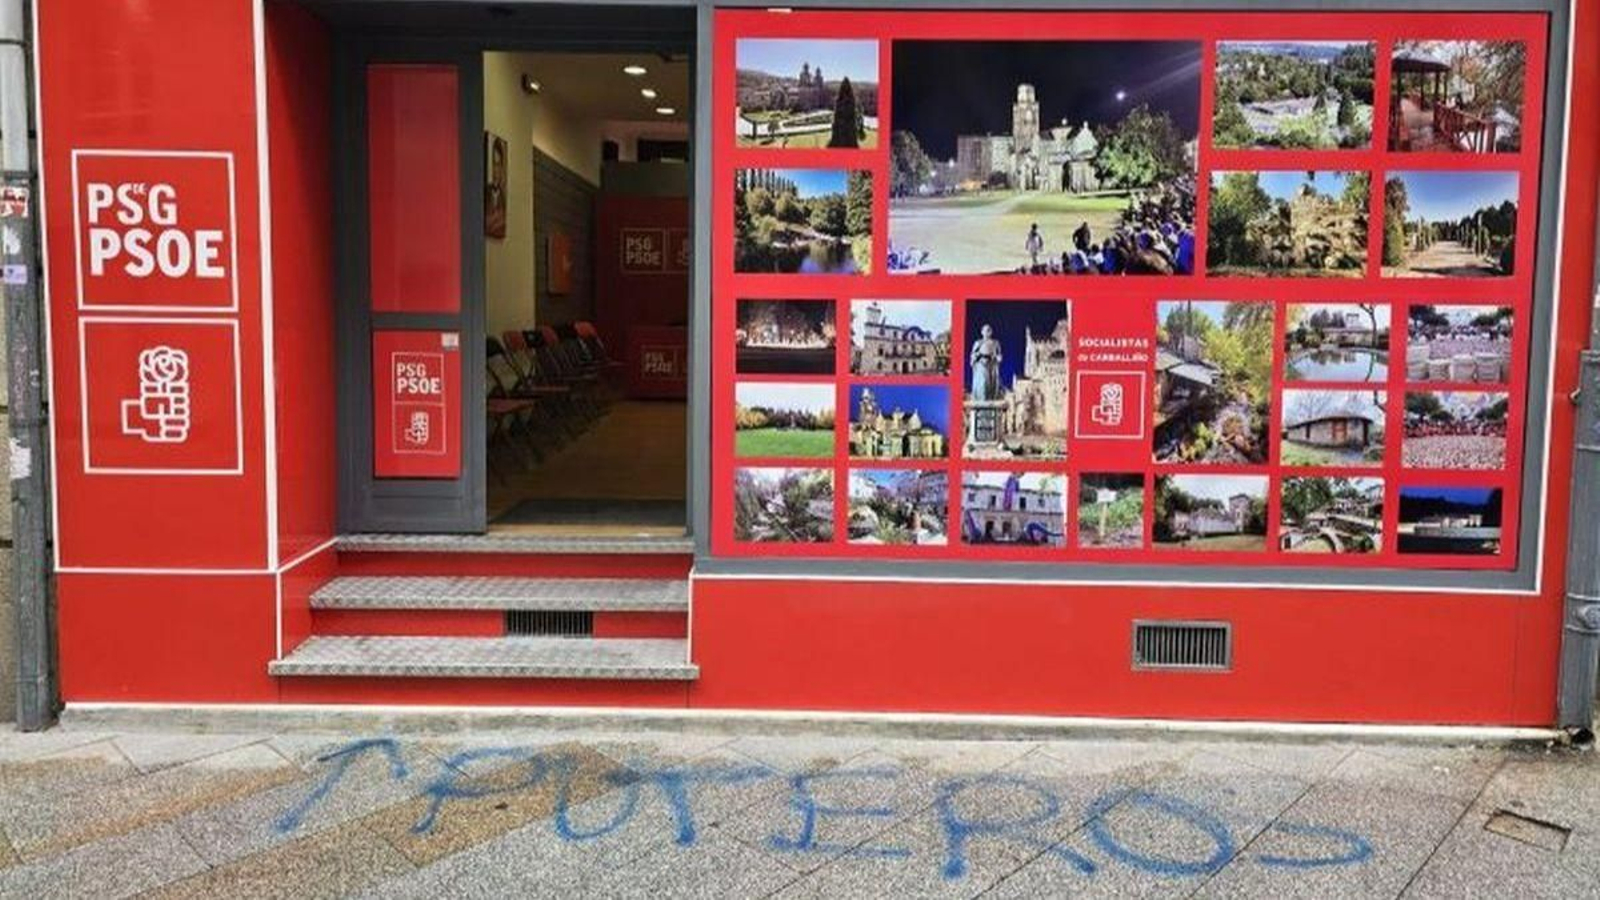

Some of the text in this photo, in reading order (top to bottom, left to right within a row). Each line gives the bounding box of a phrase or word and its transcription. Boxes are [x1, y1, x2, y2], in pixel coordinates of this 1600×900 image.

[90, 228, 225, 278] PSOE
[1078, 337, 1148, 348] SOCIALISTAS
[396, 362, 427, 377] PSG
[396, 377, 441, 394] PSOE
[410, 745, 1373, 879] PUTEROS
